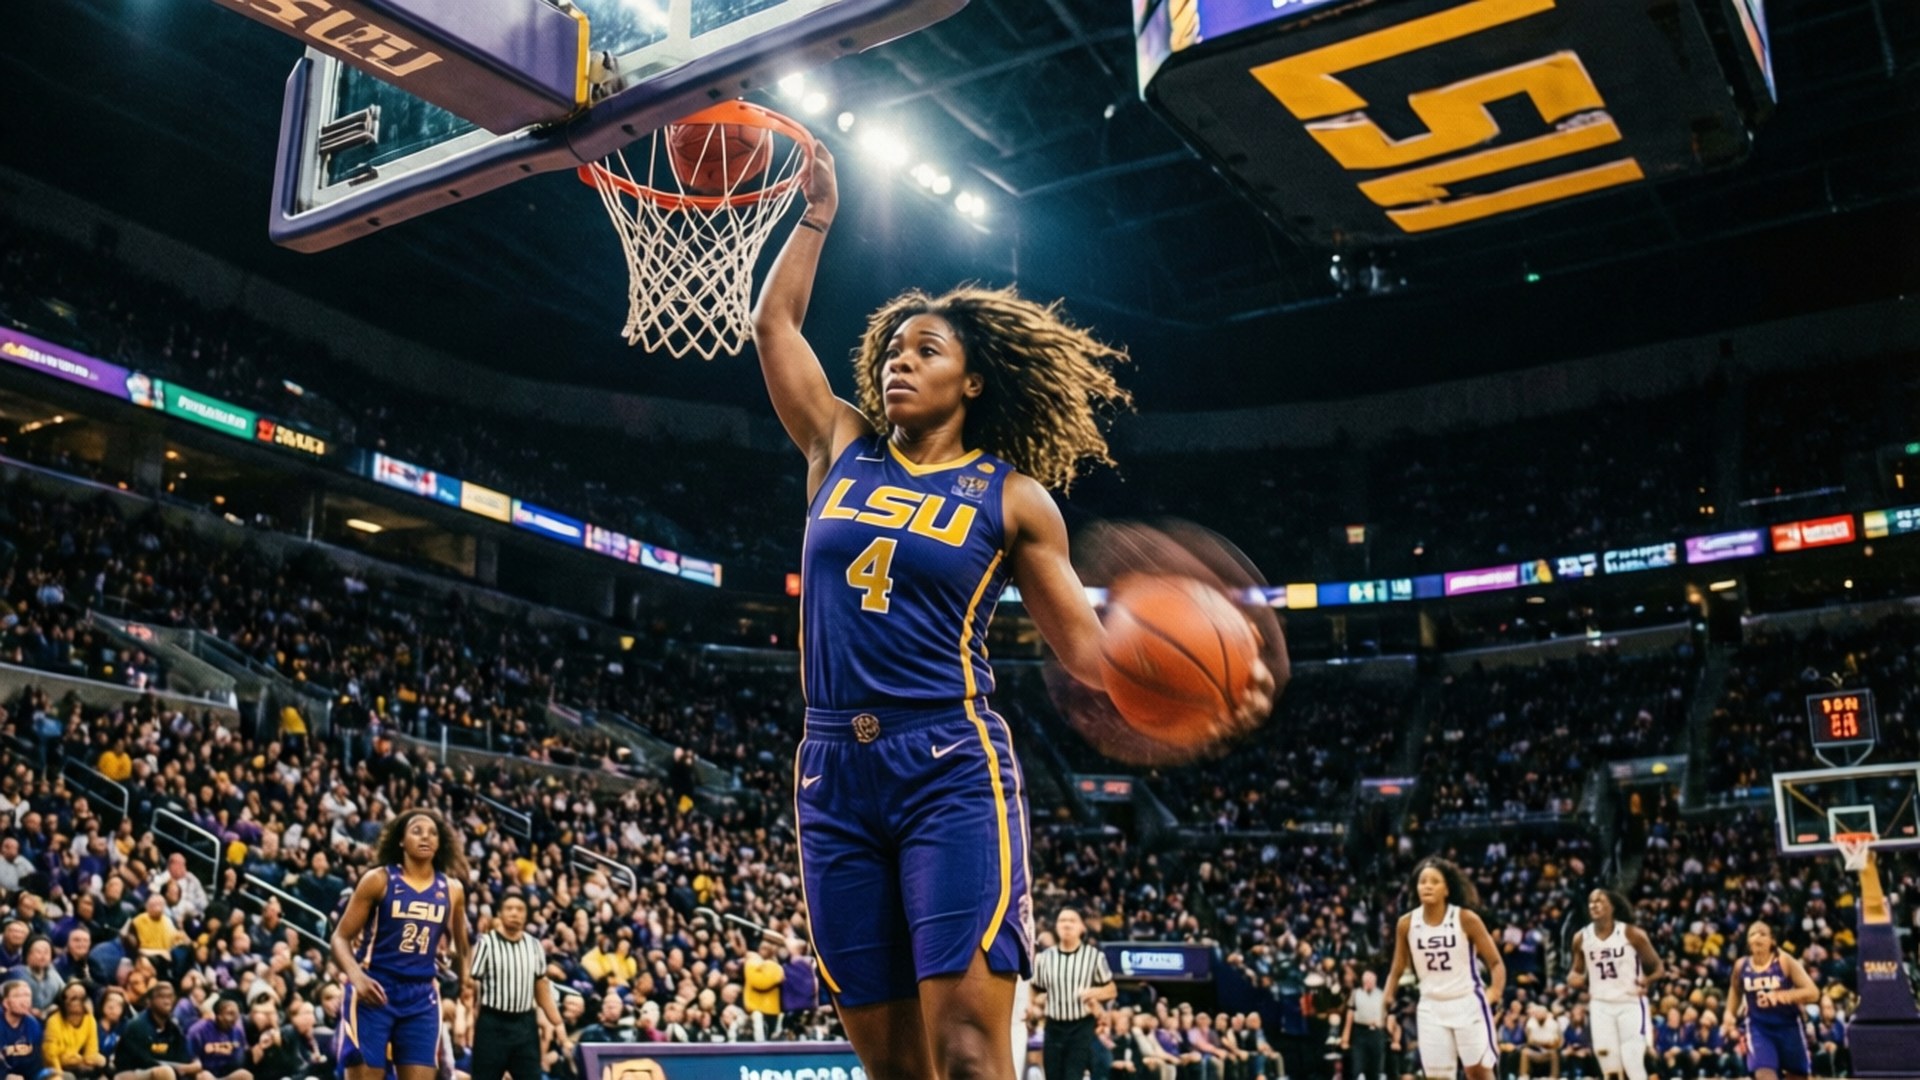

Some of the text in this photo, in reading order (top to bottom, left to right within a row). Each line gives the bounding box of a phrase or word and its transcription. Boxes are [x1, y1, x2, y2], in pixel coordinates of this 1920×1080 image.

[1249, 0, 1646, 232] LSU
[818, 478, 978, 547] LSU
[845, 537, 898, 614] 4
[391, 900, 446, 924] LSU
[399, 923, 430, 955] 24
[1417, 935, 1456, 950] LSU
[1425, 951, 1452, 971] 22
